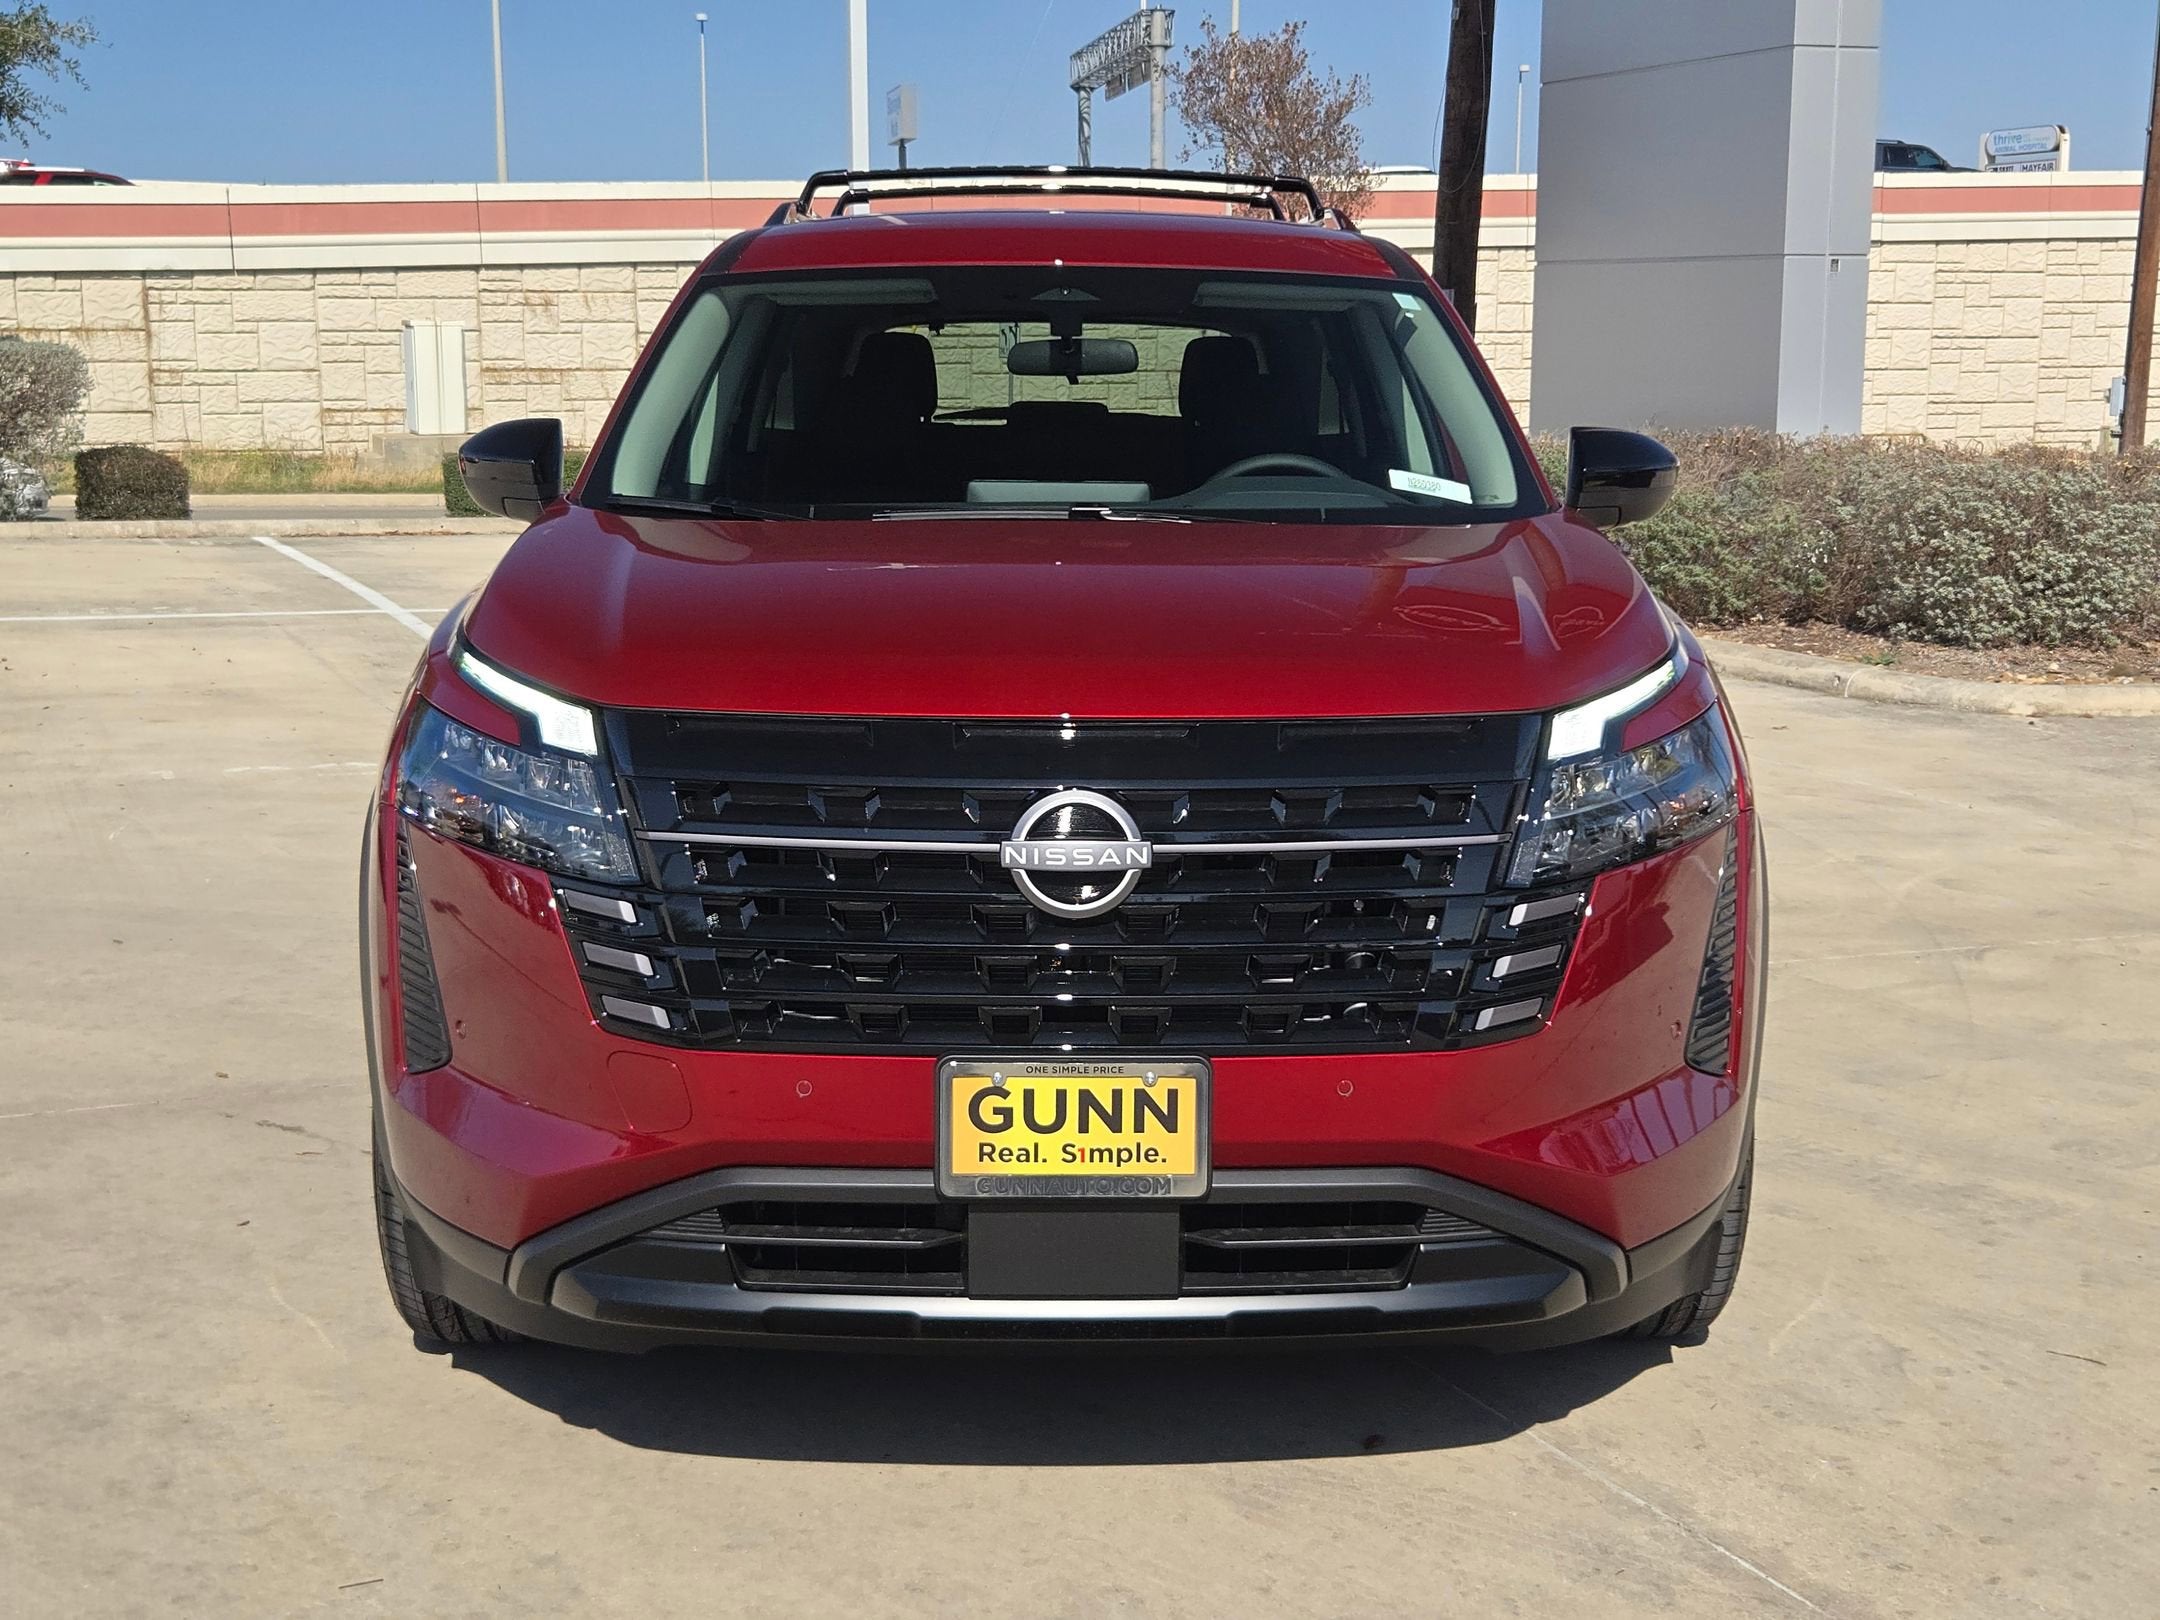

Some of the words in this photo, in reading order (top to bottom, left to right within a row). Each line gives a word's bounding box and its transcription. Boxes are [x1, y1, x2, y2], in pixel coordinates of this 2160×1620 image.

[1994, 132, 2022, 146] thrive
[2019, 143, 2047, 151] HOSPITAL
[2022, 162, 2054, 172] MAYFAIR
[1005, 846, 1148, 866] NISSAN
[1025, 1065, 1049, 1074] ONE
[1051, 1065, 1090, 1074] SIMPLE
[1093, 1065, 1125, 1074] PRICE
[967, 1086, 1179, 1134] GUNN
[978, 1142, 1048, 1163] Real.
[976, 1176, 1173, 1196] GUNNAUTO.COM
